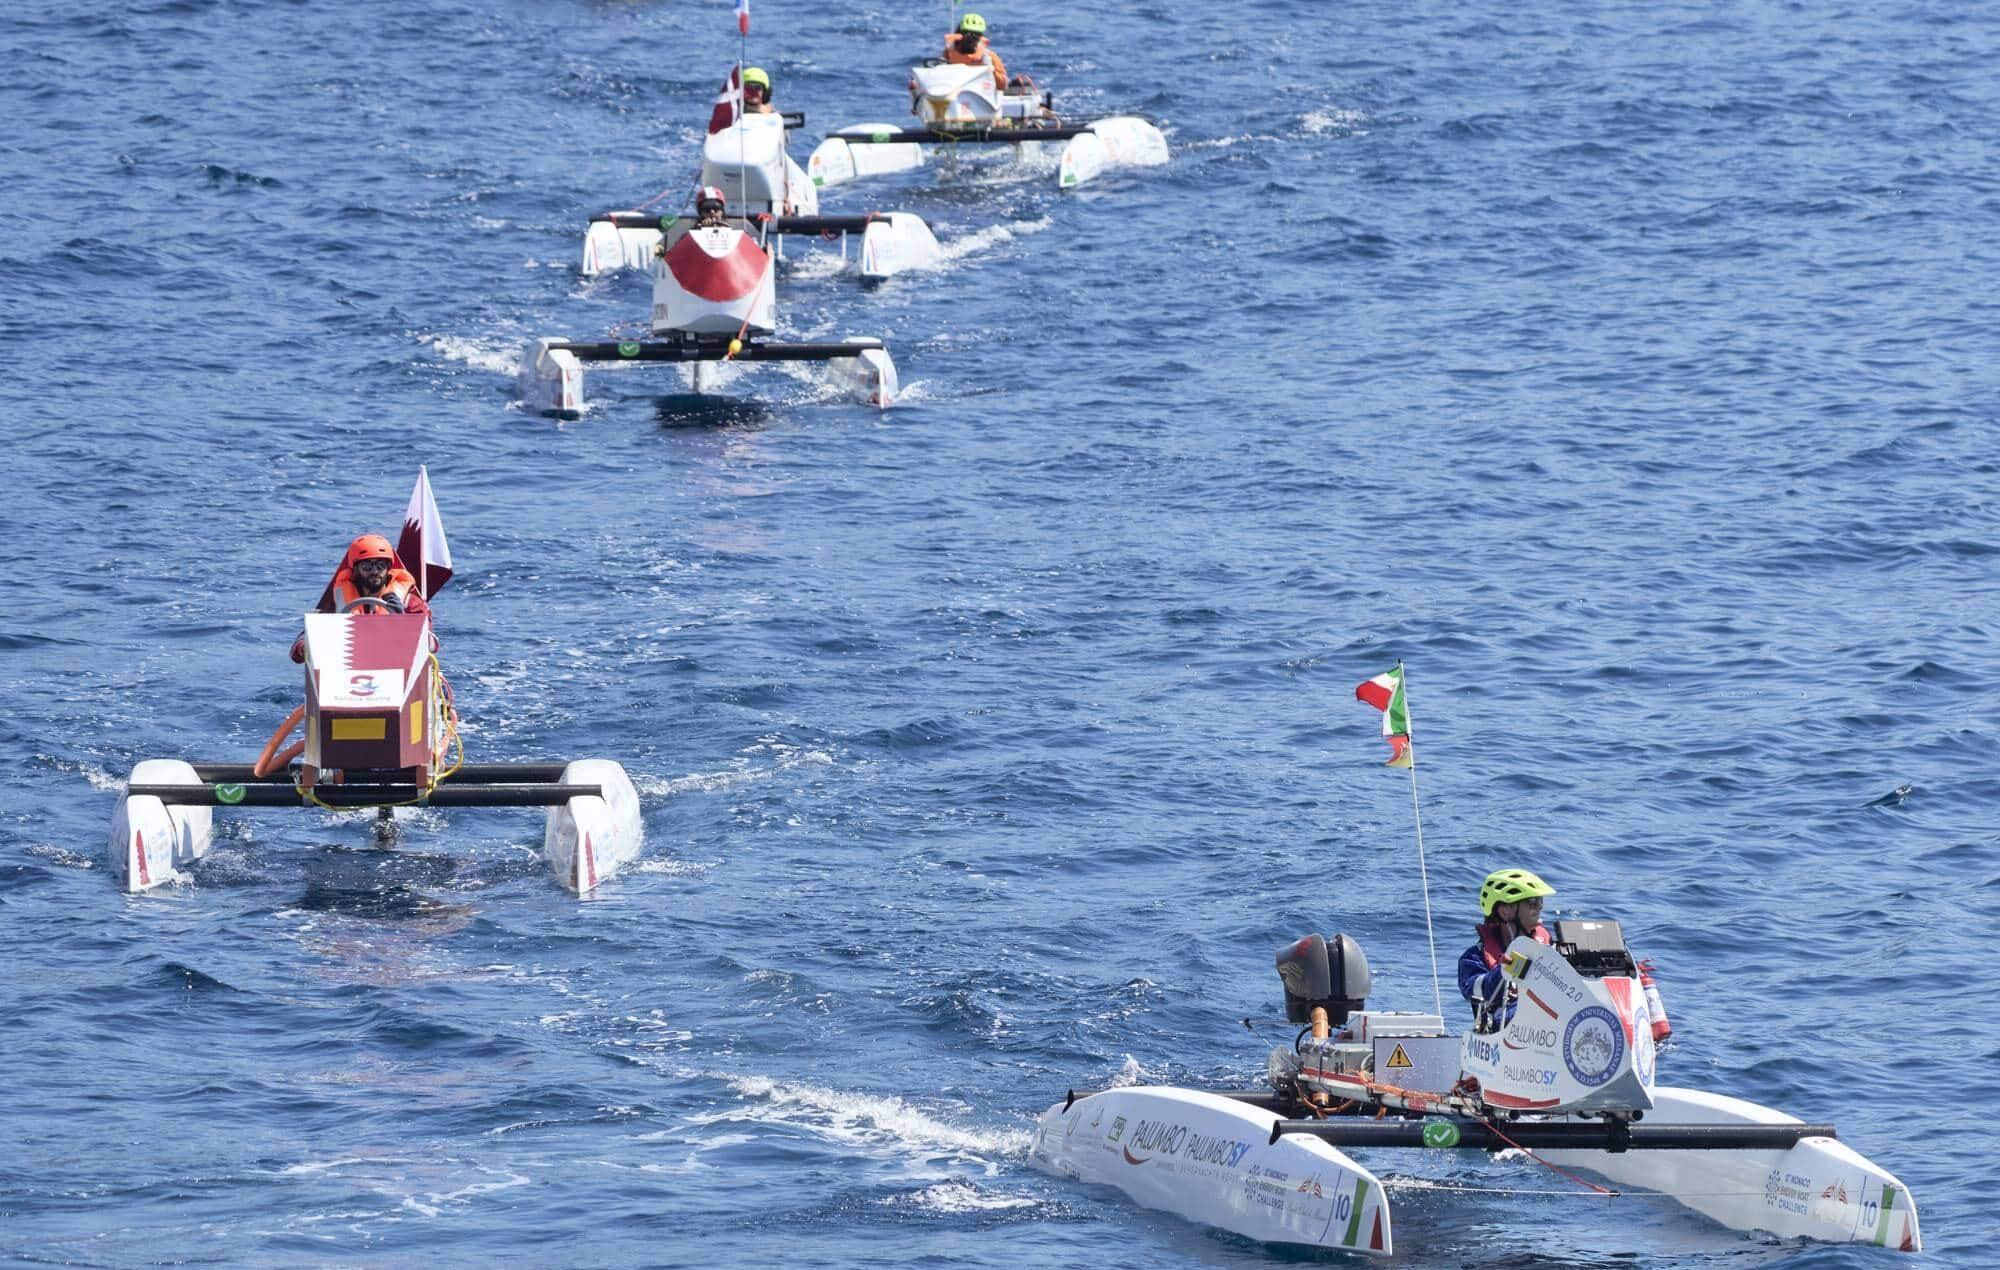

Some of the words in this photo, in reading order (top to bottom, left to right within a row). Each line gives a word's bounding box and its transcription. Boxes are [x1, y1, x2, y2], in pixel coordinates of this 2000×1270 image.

[1508, 1024, 1557, 1048] PALUMBO
[1473, 1038, 1491, 1062] MEB
[1503, 1064, 1558, 1085] PALUMBOSY
[1130, 1119, 1187, 1155] PALUMBO
[1183, 1133, 1250, 1168] PALUMBOSY
[1256, 1193, 1285, 1210] CHALLENGE
[1335, 1193, 1351, 1222] 10
[1778, 1199, 1808, 1216] CHALLENGE
[1862, 1200, 1877, 1227] 10
